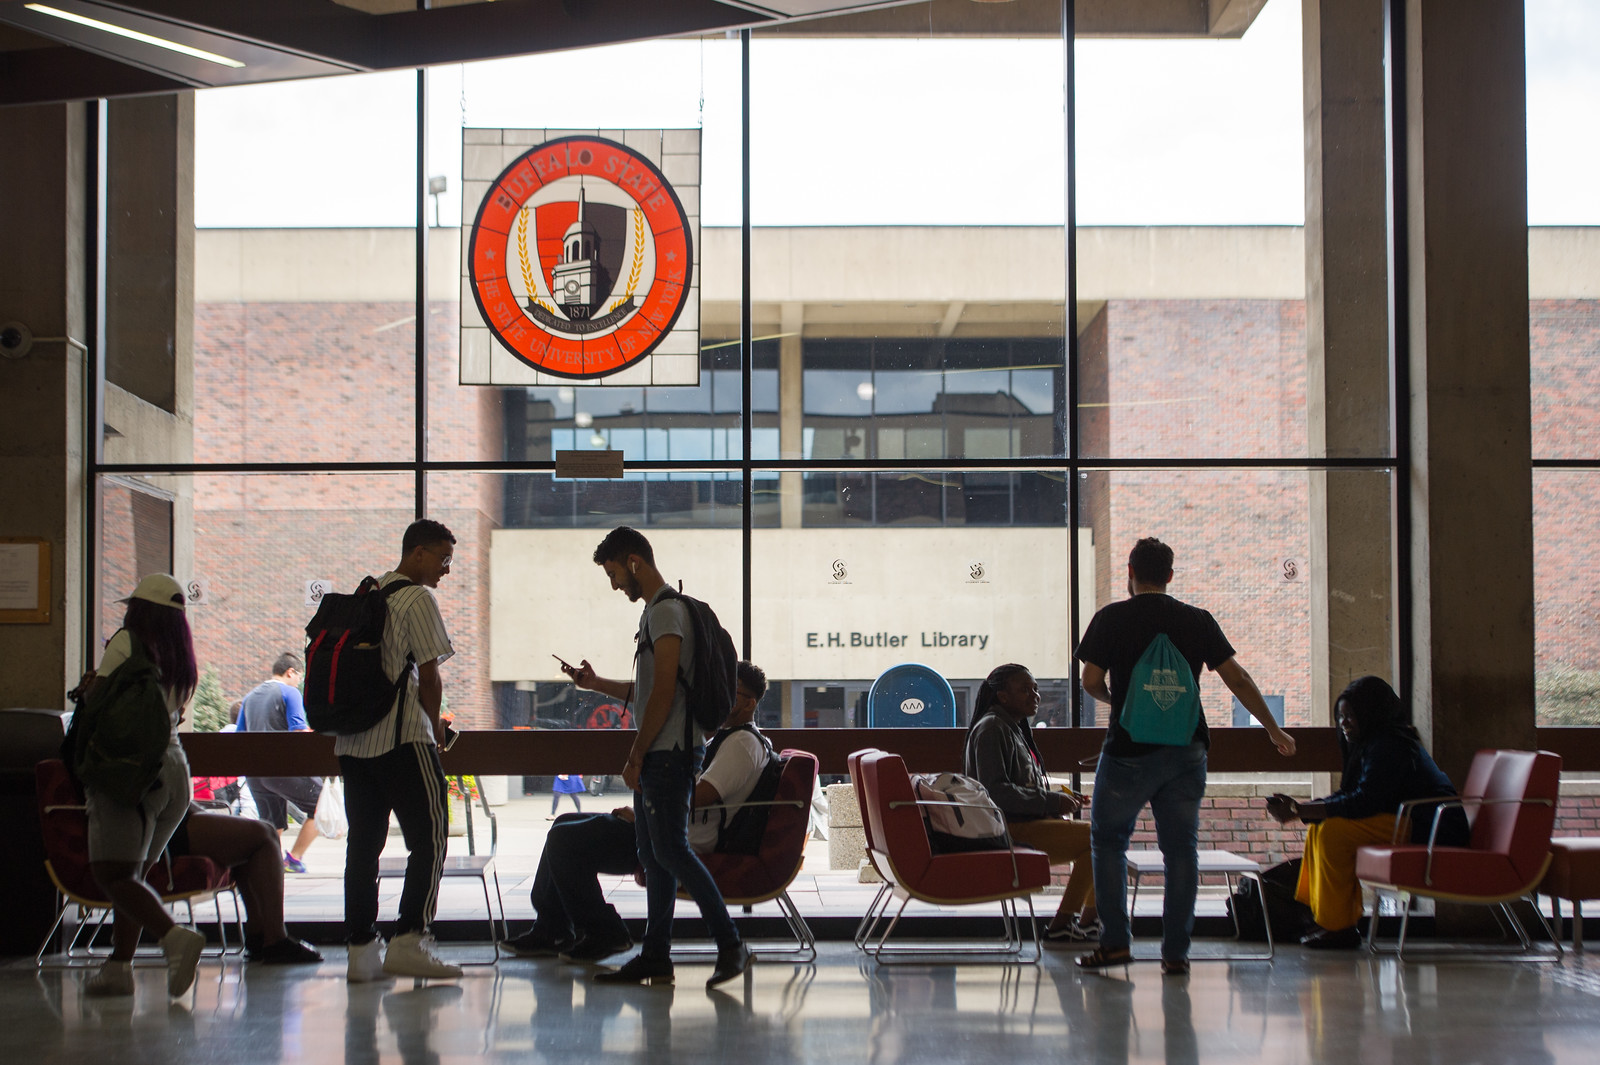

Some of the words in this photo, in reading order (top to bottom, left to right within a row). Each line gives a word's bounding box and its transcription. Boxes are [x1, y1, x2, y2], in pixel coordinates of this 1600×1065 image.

[495, 149, 594, 213] BUFFALO
[604, 155, 667, 212] STATE
[483, 269, 500, 300] THE
[494, 302, 528, 342] STATE
[530, 337, 616, 365] UNIVERSITY
[620, 335, 636, 354] OF
[638, 306, 665, 340] NEW
[660, 269, 682, 306] YORK
[534, 309, 571, 331] DEDICATED
[575, 323, 586, 332] TO
[587, 308, 628, 332] EXCELLENCE
[569, 306, 591, 319] 1871
[921, 631, 989, 650] Library
